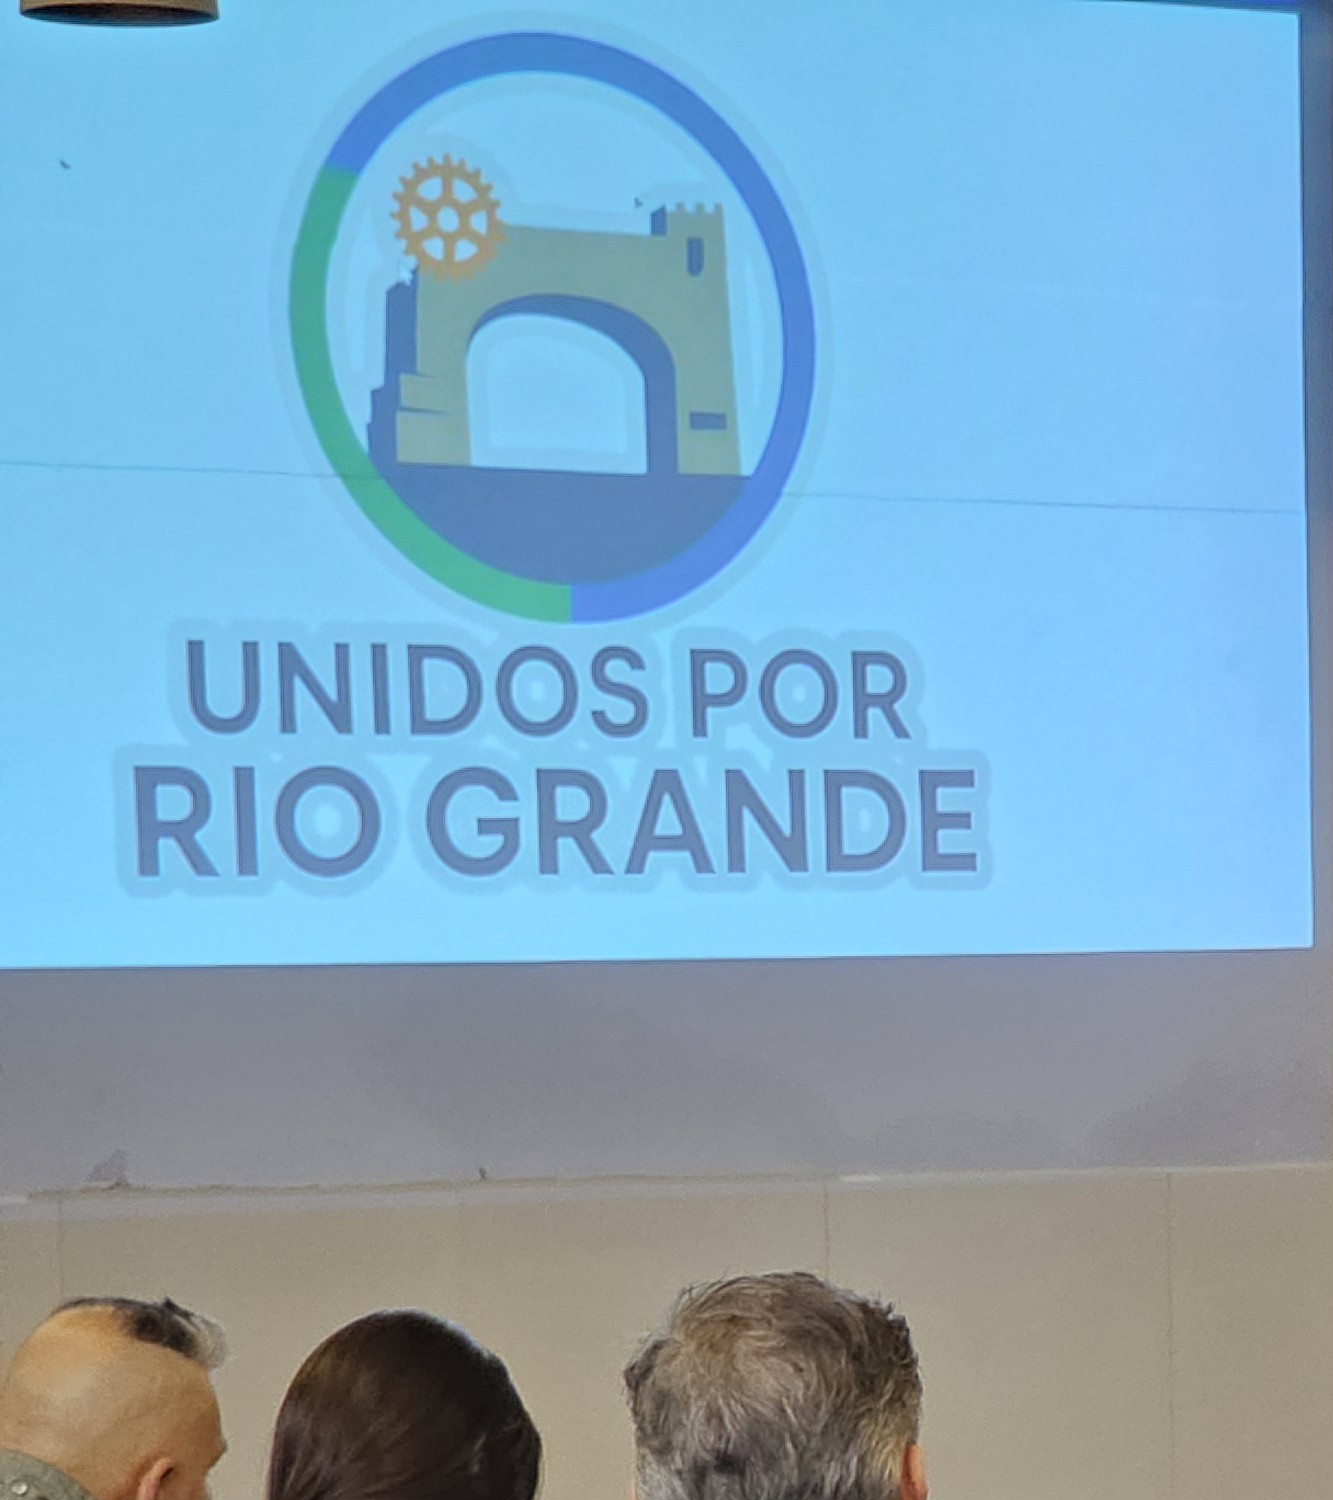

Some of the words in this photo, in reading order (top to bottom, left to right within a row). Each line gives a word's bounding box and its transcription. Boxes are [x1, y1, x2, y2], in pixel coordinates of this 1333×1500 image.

[187, 639, 648, 737] UNIDOS
[690, 648, 911, 740] POR
[133, 766, 381, 877] RIO
[425, 766, 979, 875] GRANDE
